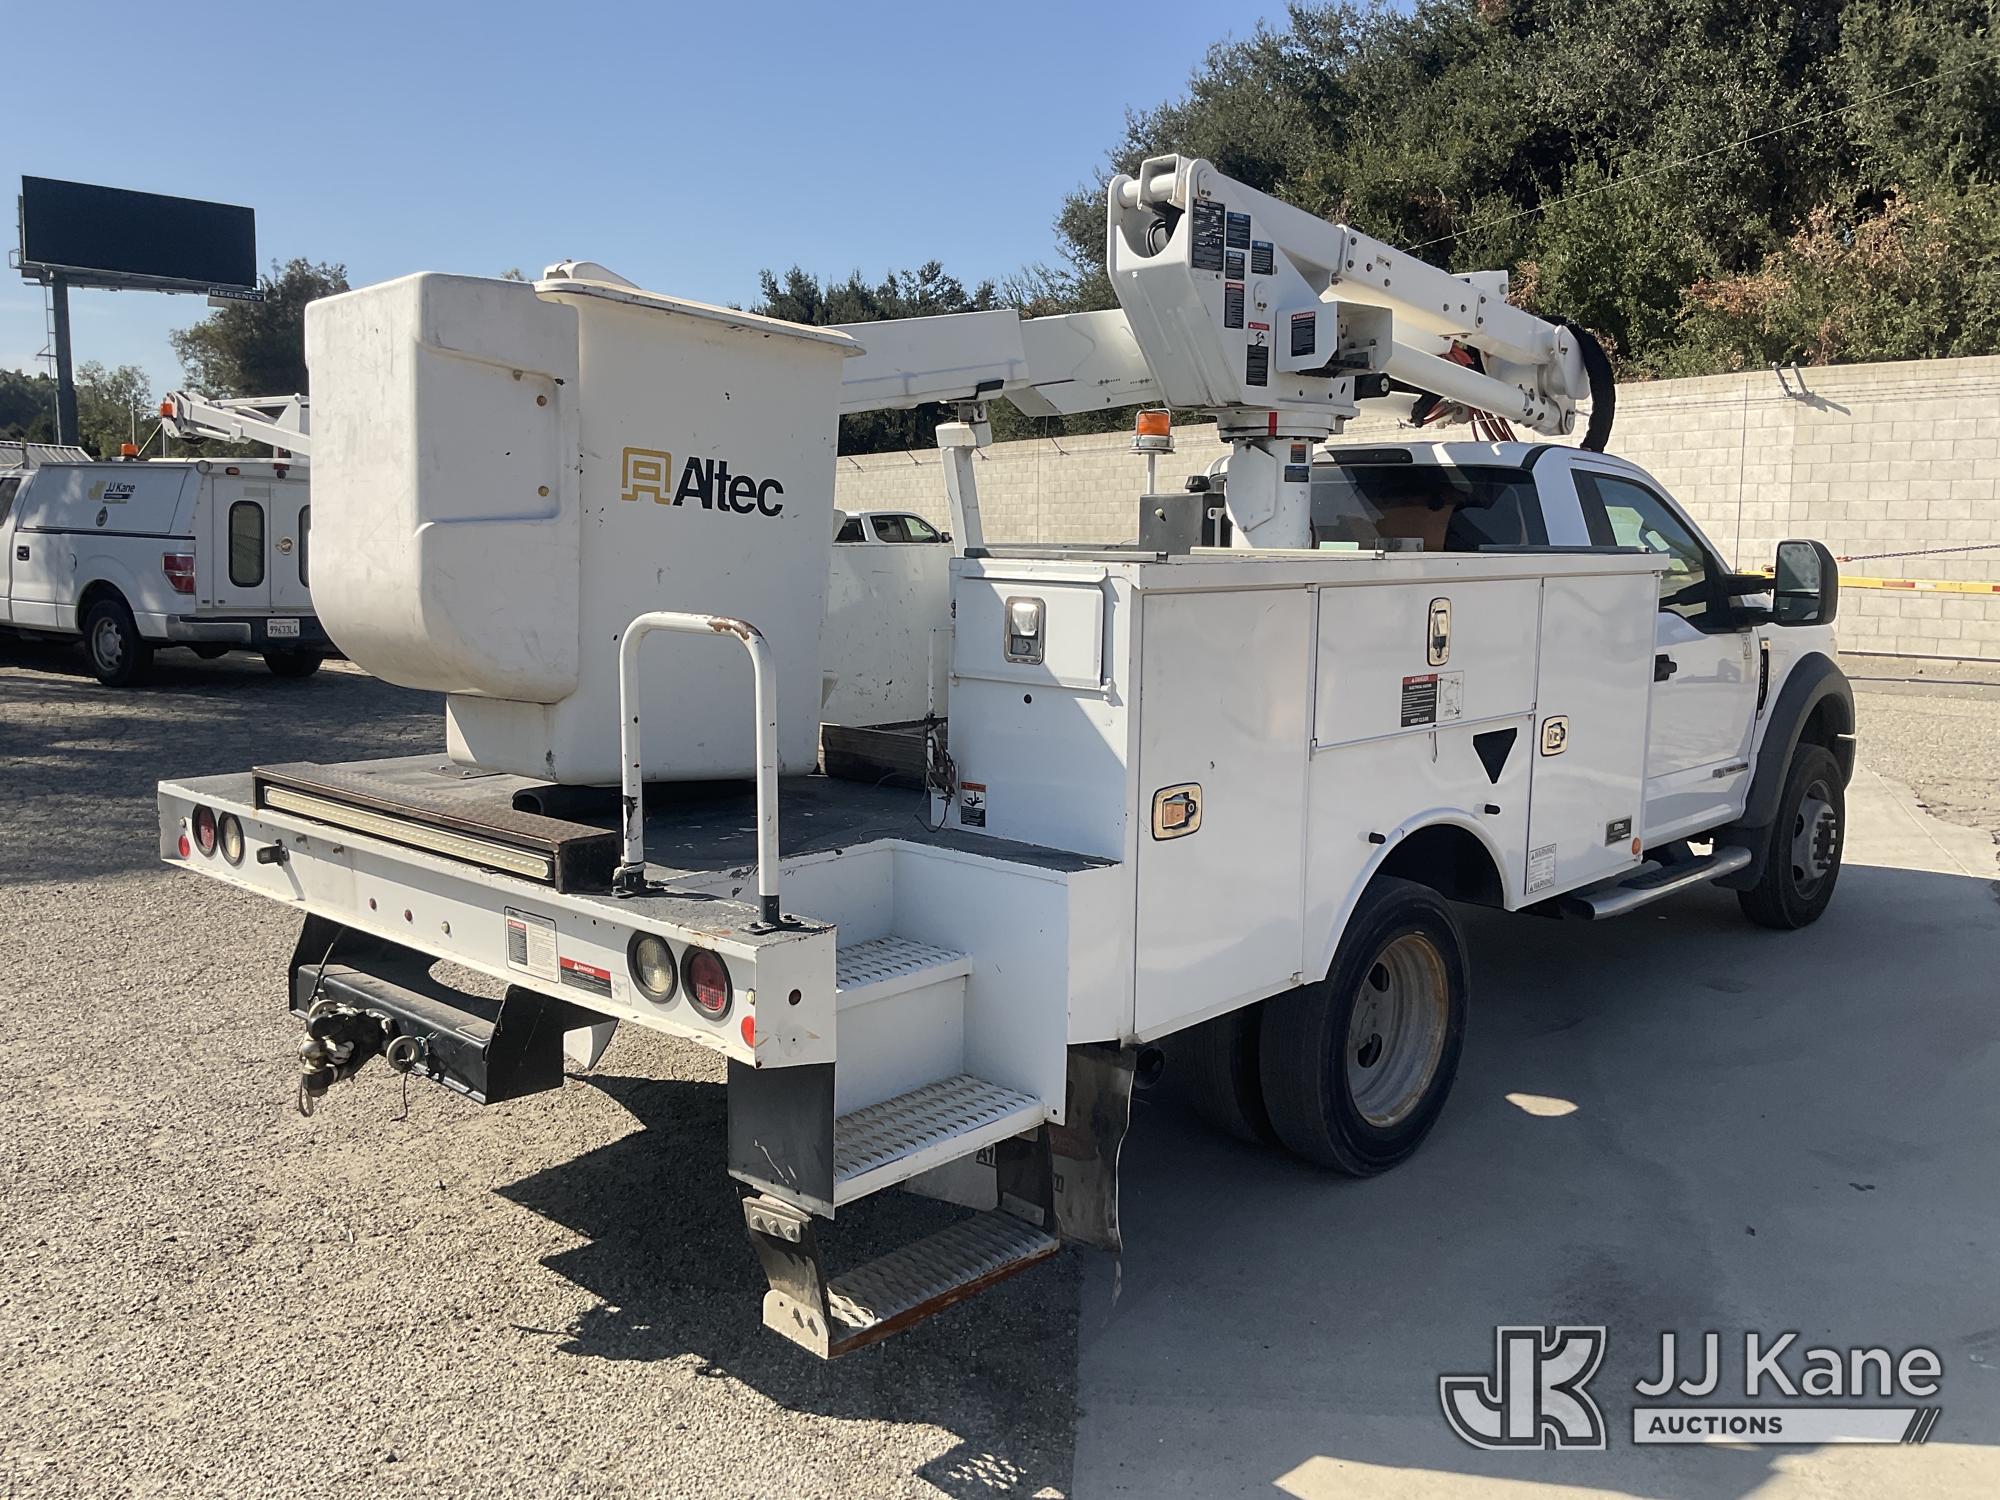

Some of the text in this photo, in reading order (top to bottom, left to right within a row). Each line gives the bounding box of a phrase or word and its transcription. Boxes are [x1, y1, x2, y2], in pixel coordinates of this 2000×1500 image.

[211, 289, 262, 301] REGENCY
[115, 482, 136, 493] Kane
[672, 456, 784, 517] Altec
[577, 964, 596, 975] DANGER
